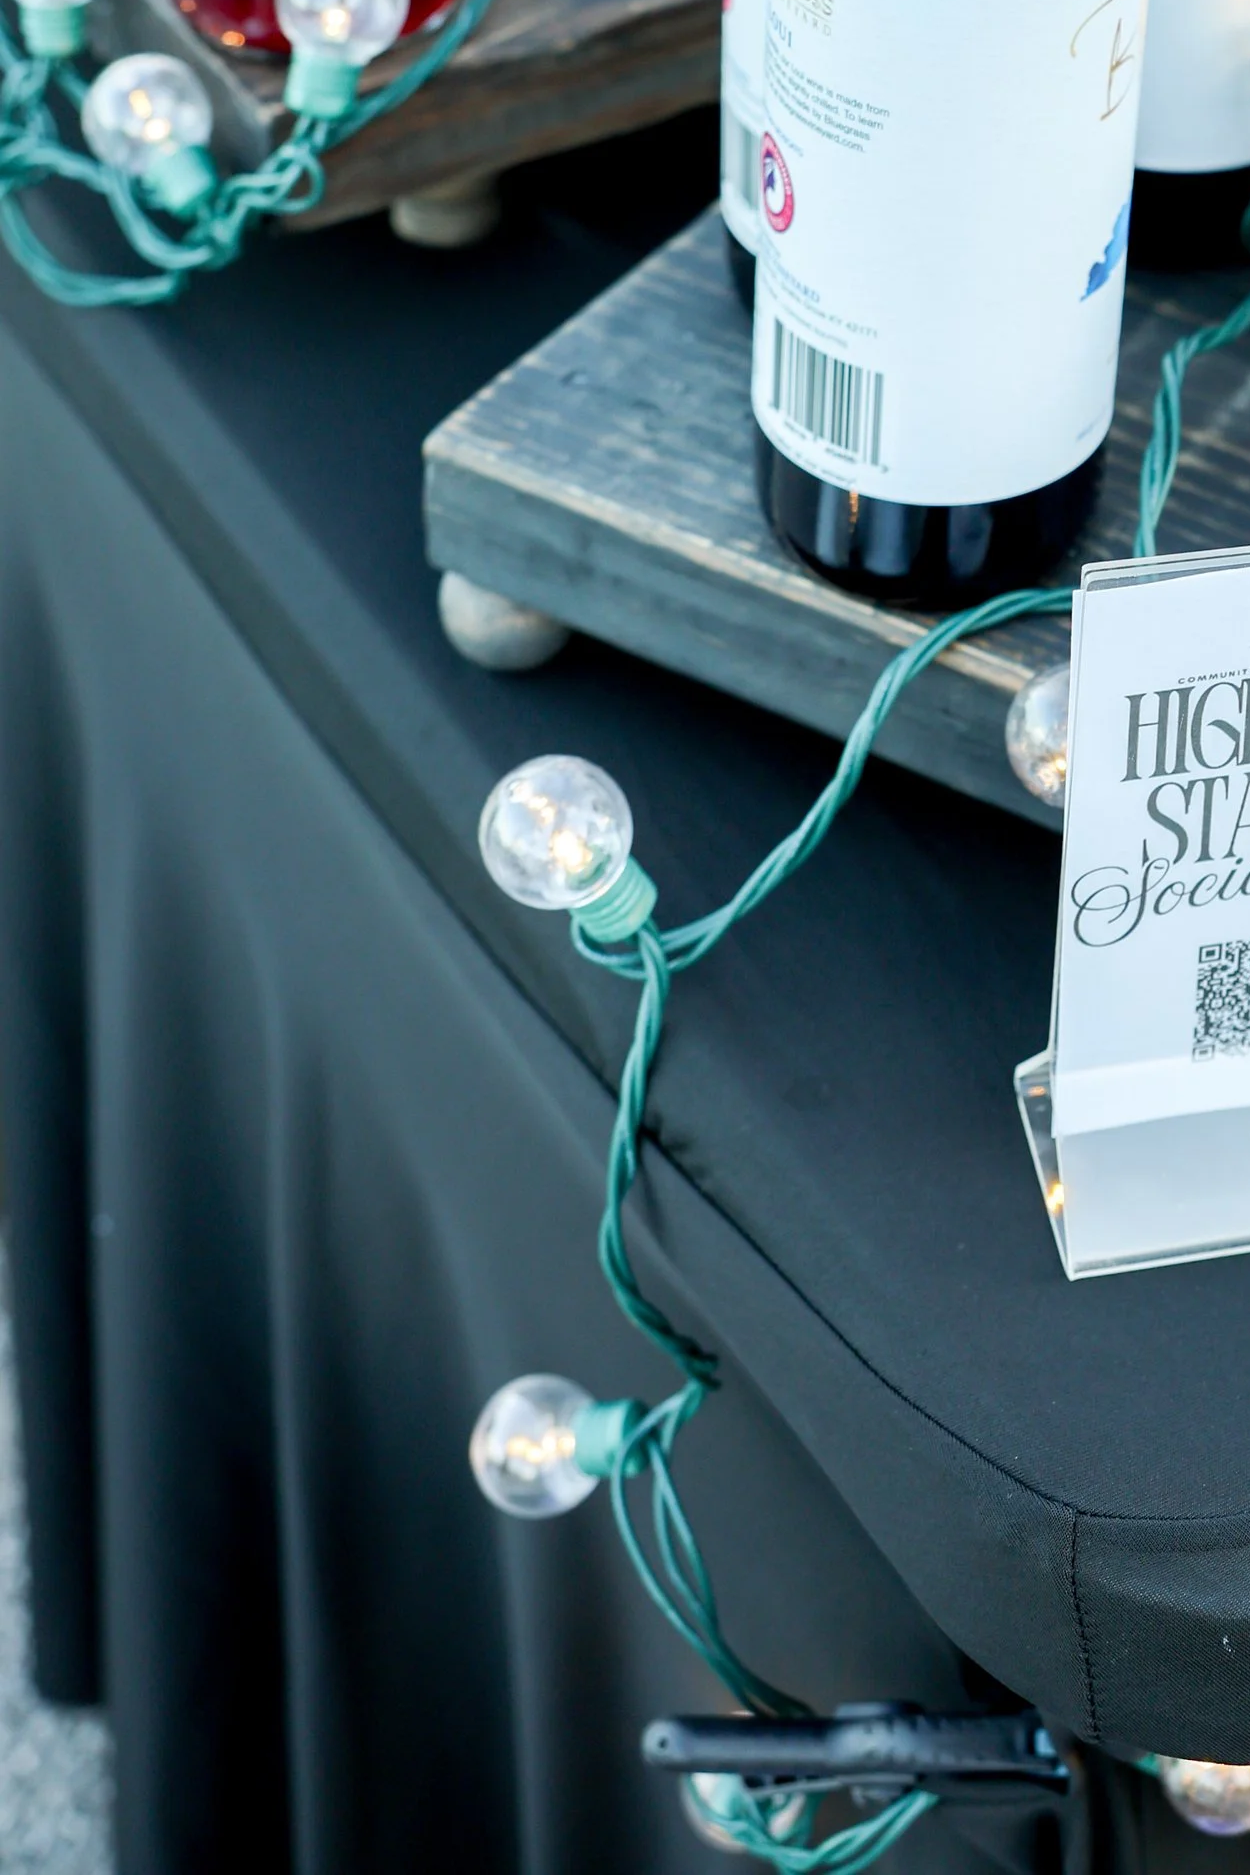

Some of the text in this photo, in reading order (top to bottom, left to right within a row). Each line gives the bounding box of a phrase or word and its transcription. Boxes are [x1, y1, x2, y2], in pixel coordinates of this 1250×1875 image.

[836, 93, 863, 110] made
[865, 103, 891, 118] from
[824, 114, 871, 141] Bluegrass
[844, 108, 856, 122] To
[858, 114, 884, 130] learn
